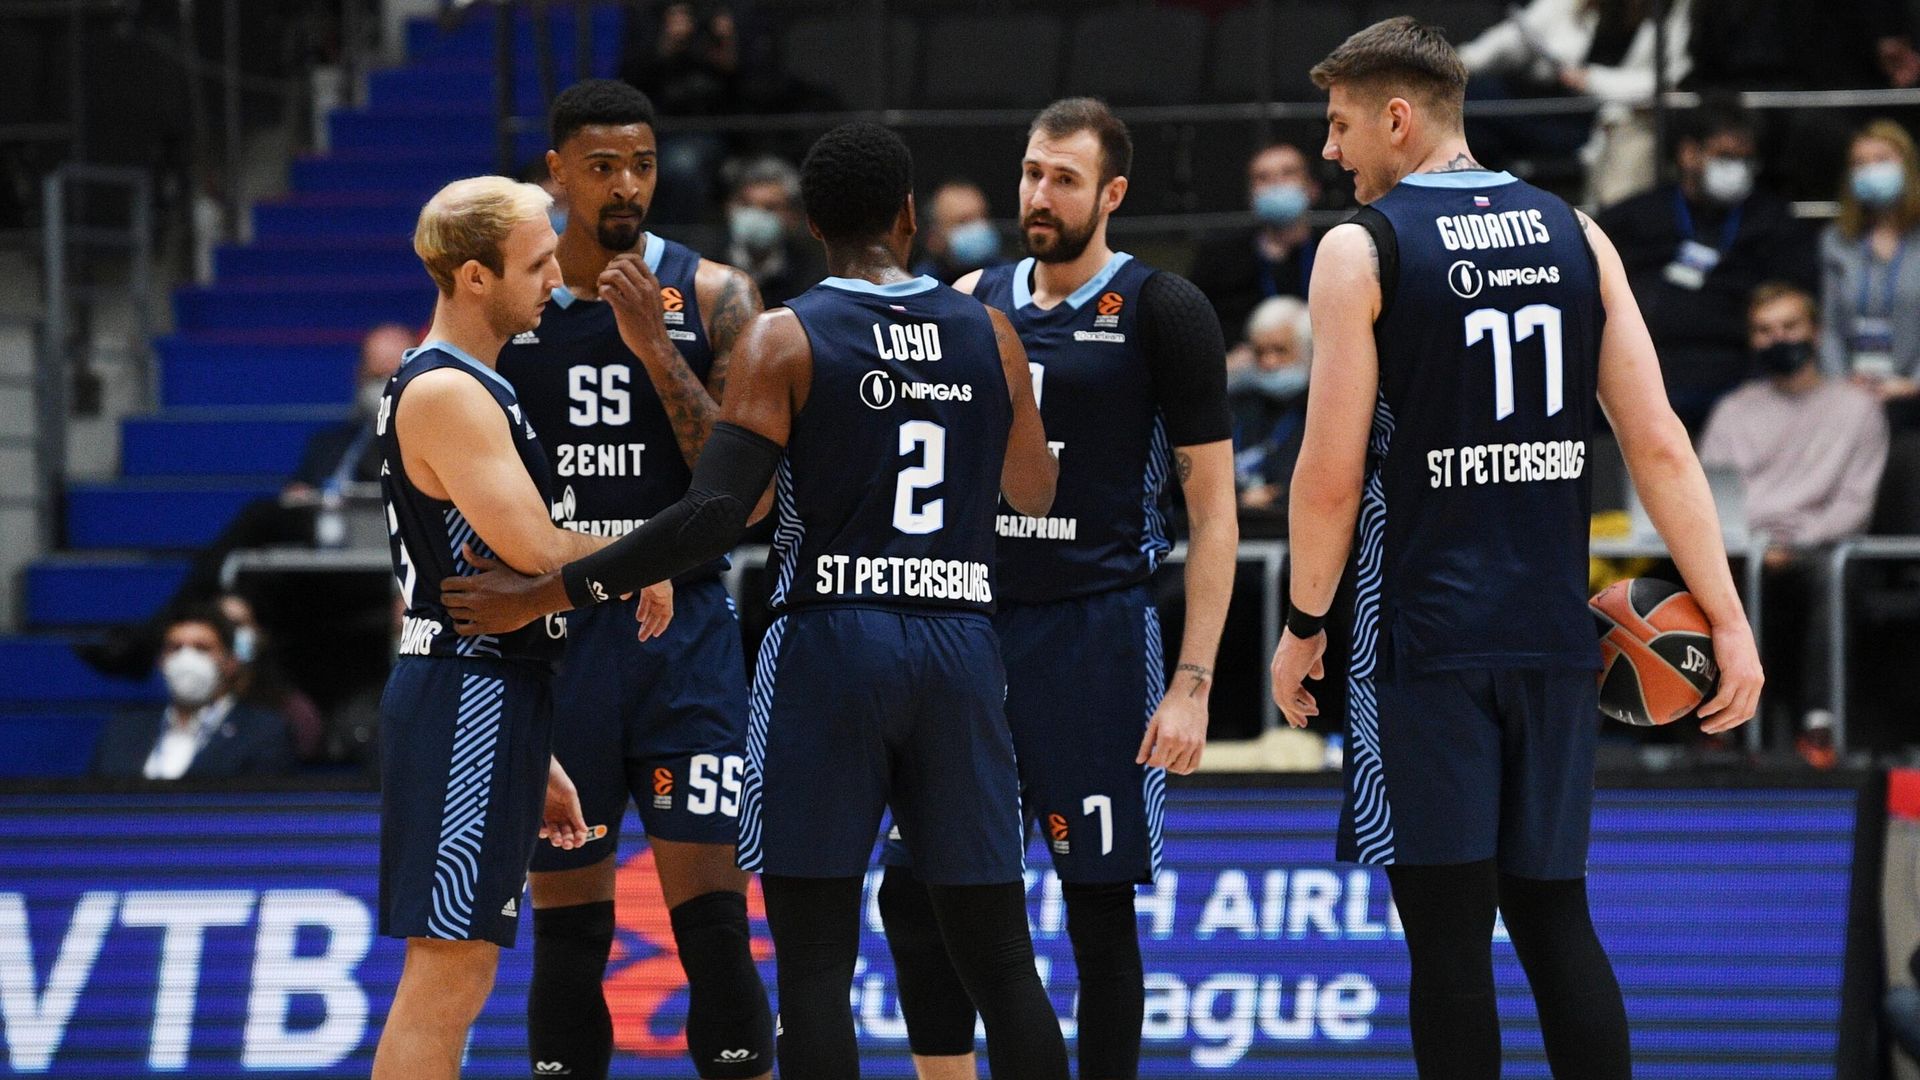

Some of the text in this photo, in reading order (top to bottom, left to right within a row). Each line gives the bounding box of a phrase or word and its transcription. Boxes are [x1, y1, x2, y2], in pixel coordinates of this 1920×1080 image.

[1436, 209, 1550, 250] GUDAITIS
[1488, 266, 1560, 287] NIPIGAS
[872, 322, 943, 361] LOYD
[1464, 303, 1564, 421] 77
[901, 381, 973, 402] NIPIGAS
[893, 420, 946, 535] 2
[1427, 440, 1585, 489] ST PETERSBURG
[999, 515, 1077, 541] GAZPROM
[816, 554, 992, 603] ST PETERSBURG
[1082, 794, 1113, 857] 7
[1194, 868, 1406, 941] AIRL
[0, 888, 374, 1073] VTB
